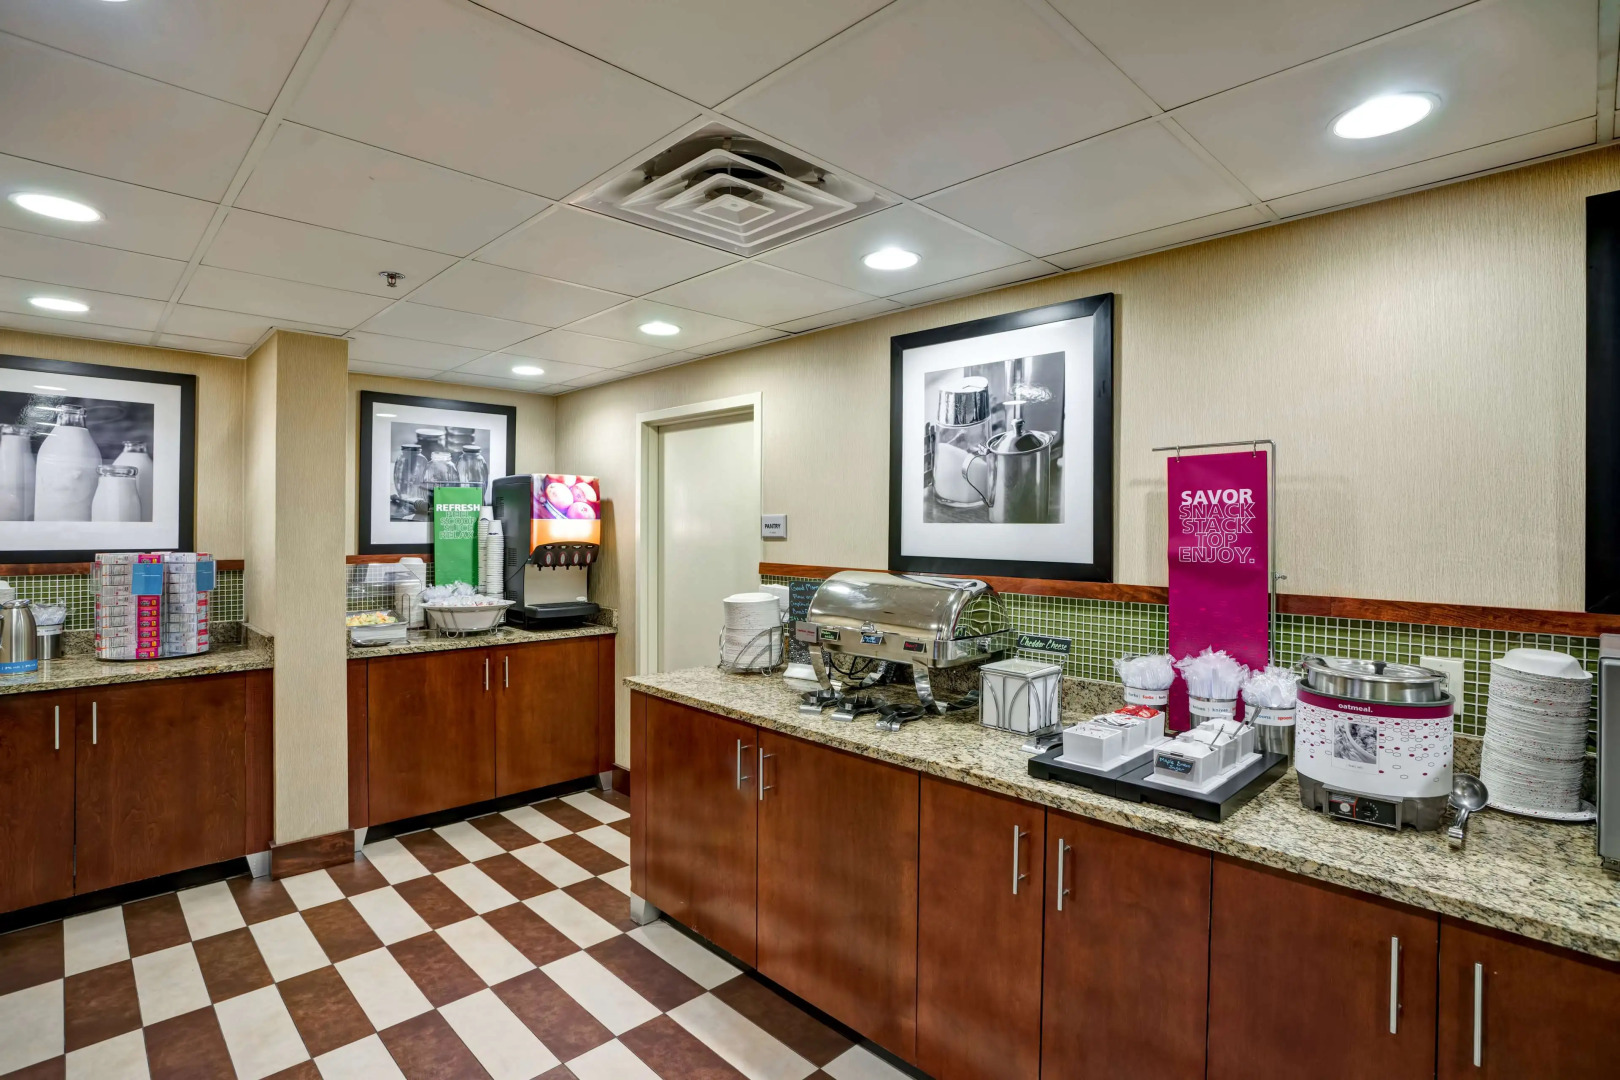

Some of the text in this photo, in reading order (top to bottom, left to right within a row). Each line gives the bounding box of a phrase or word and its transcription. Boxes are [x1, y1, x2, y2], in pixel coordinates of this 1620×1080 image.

[1181, 489, 1253, 505] SAVOR
[436, 503, 480, 512] REFRESH
[1179, 502, 1256, 519] SNACK
[1182, 517, 1253, 534] STACK
[1195, 532, 1238, 548] TOP
[1178, 546, 1255, 563] ENJOY.
[1045, 639, 1068, 650] Cheese
[1338, 703, 1373, 713] oatmeal.
